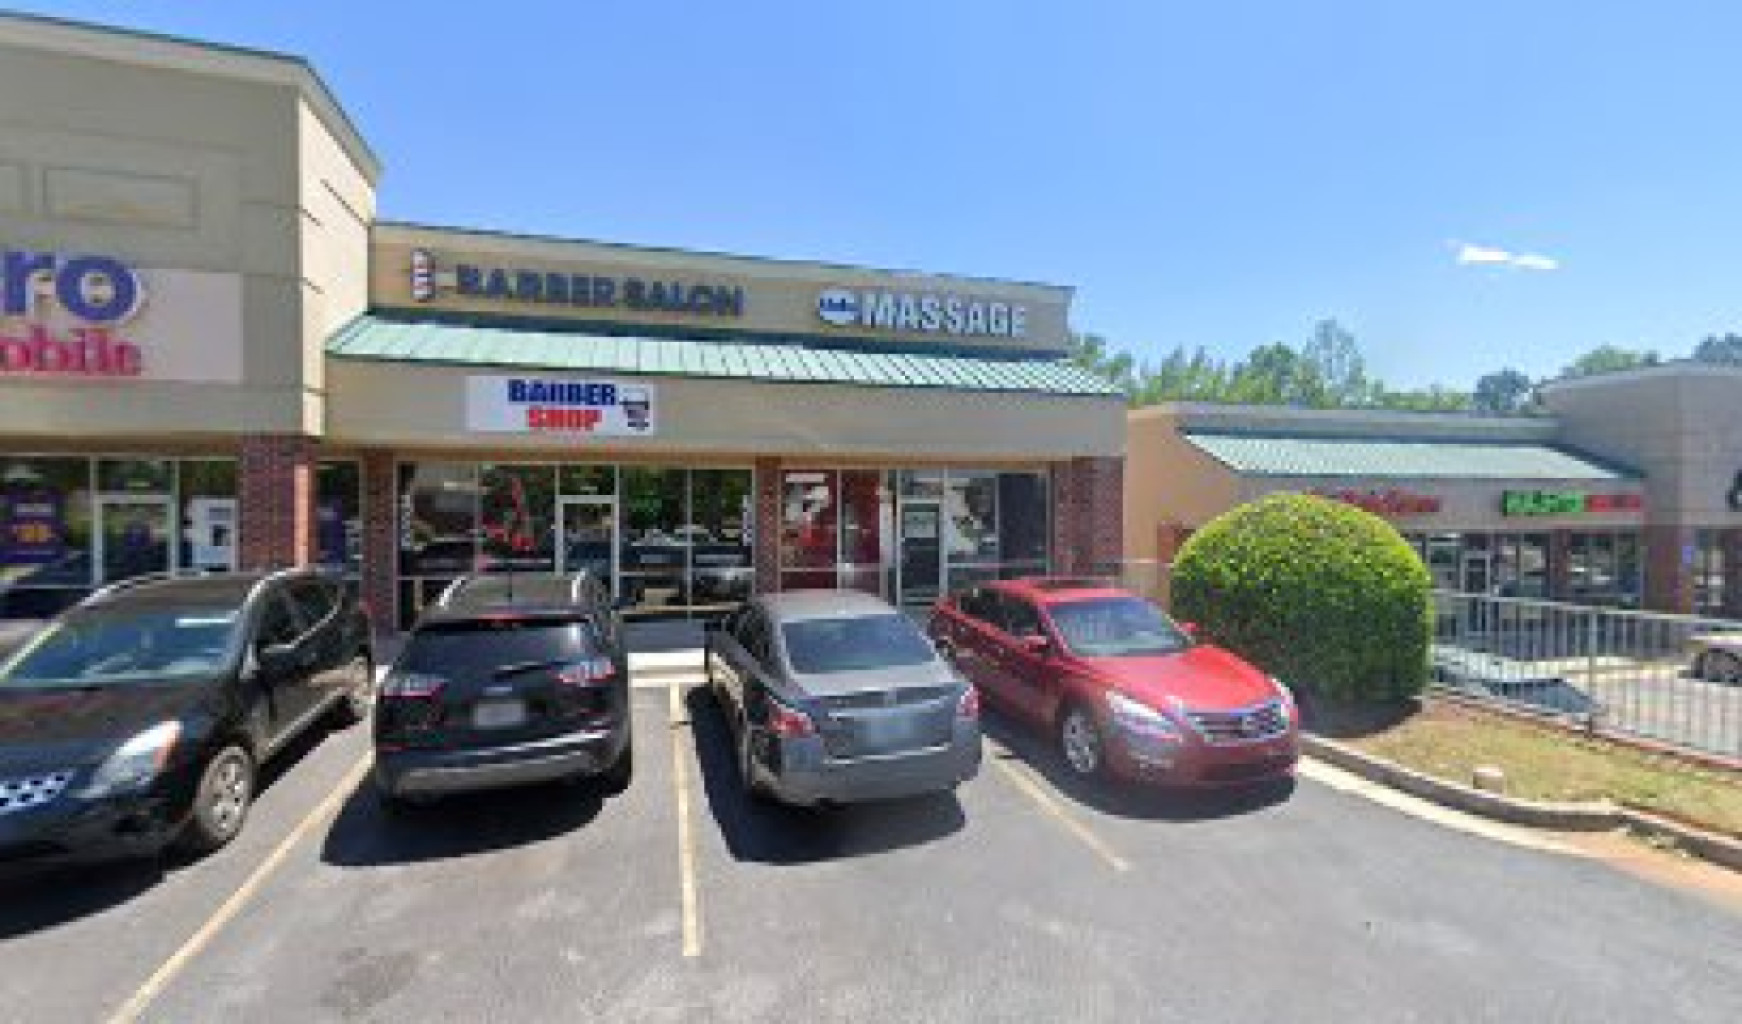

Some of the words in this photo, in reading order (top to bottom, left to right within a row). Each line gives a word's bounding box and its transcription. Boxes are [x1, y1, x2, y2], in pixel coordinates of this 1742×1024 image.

[456, 264, 616, 308] BARBER
[622, 276, 744, 317] SALON
[860, 290, 1028, 338] MASSAGE
[507, 379, 616, 405] BARBER
[526, 408, 602, 431] SHOP
